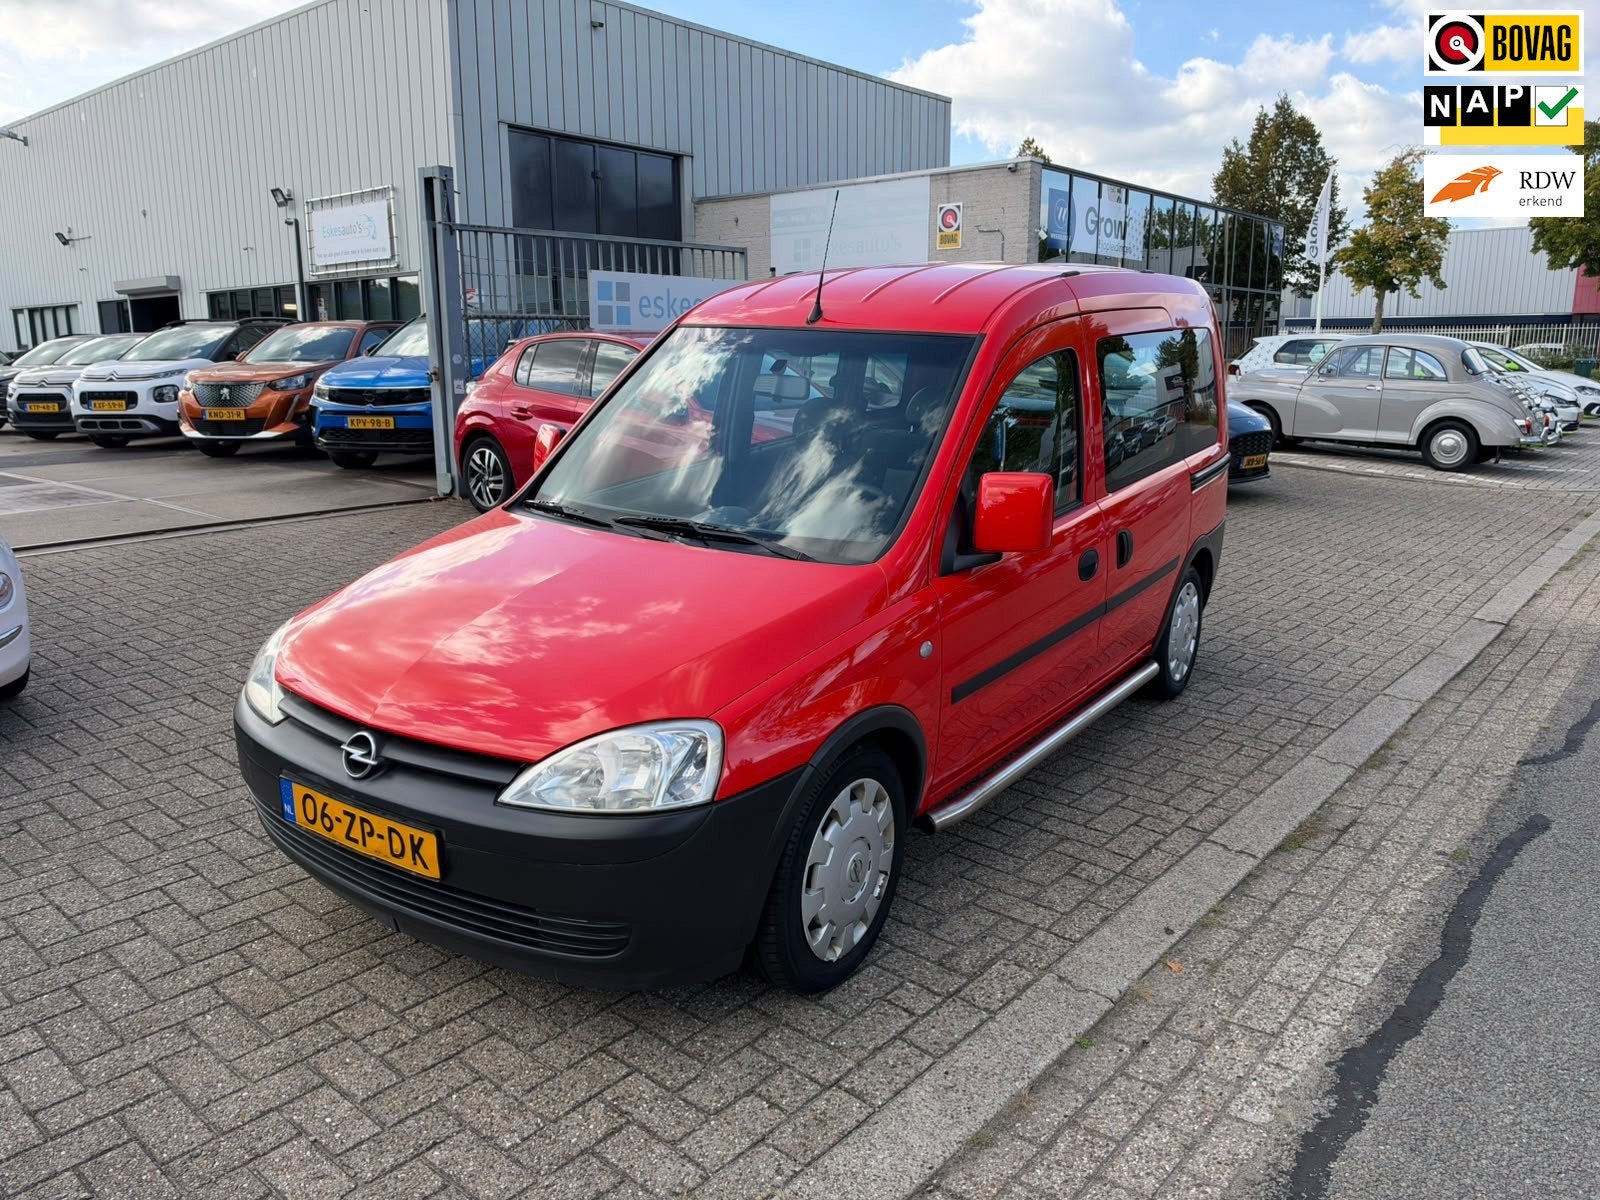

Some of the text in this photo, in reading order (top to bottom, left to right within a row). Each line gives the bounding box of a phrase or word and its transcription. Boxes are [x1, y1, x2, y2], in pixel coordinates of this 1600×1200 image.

[940, 233, 958, 245] BOVAG
[639, 288, 700, 318] eske
[208, 410, 242, 419] KND-31-R
[350, 418, 391, 428] KPV-98-B
[284, 804, 294, 815] NL
[302, 793, 430, 870] 06-ZP-DK
